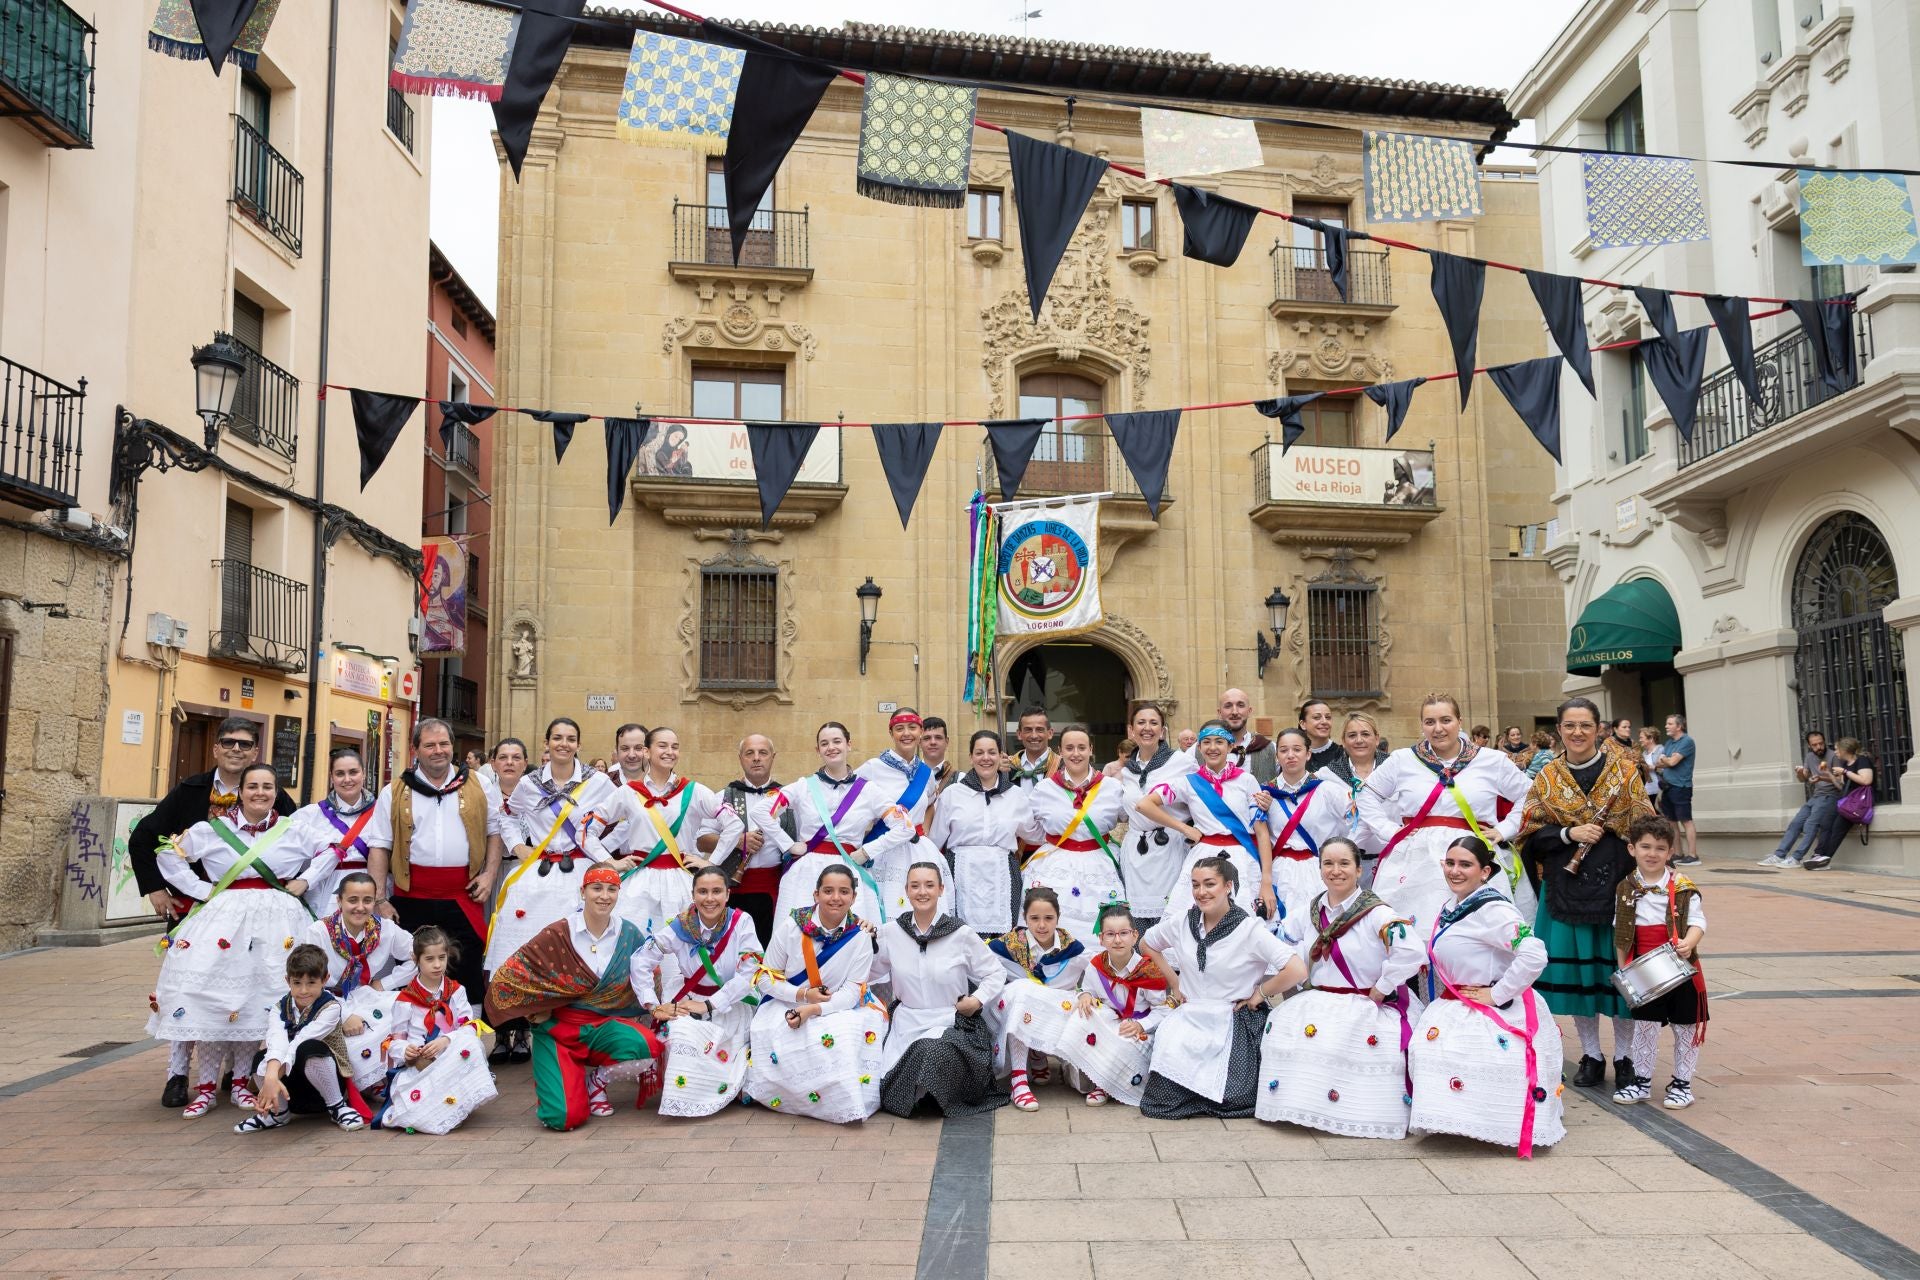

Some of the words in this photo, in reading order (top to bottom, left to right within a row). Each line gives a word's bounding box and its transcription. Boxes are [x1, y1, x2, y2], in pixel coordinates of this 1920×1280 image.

[729, 457, 747, 470] de
[1295, 456, 1361, 476] MUSEO
[1296, 479, 1311, 492] de
[1314, 480, 1328, 493] La
[1330, 481, 1362, 495] Rioja
[1012, 523, 1036, 544] DANZAS
[1045, 522, 1062, 536] AIRES
[1069, 536, 1081, 549] LA
[1575, 650, 1633, 664] MATASELLOS
